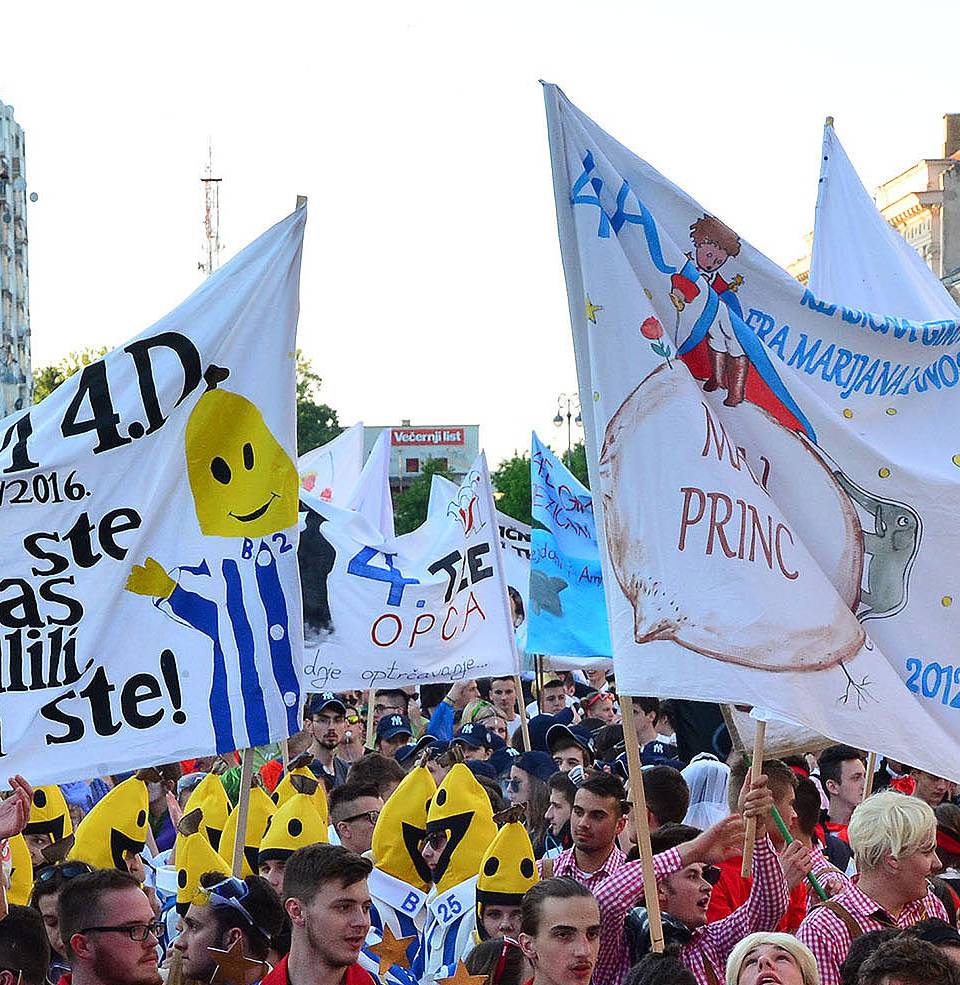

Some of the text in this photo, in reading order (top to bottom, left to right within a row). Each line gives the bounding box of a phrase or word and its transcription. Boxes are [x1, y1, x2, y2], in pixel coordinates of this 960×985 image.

[60, 331, 204, 456] 4.D
[443, 430, 462, 442] list
[23, 507, 143, 577] ste
[678, 487, 799, 580] PRINC
[347, 546, 426, 609] 4.
[39, 648, 187, 746] ste!
[437, 893, 462, 923] 25
